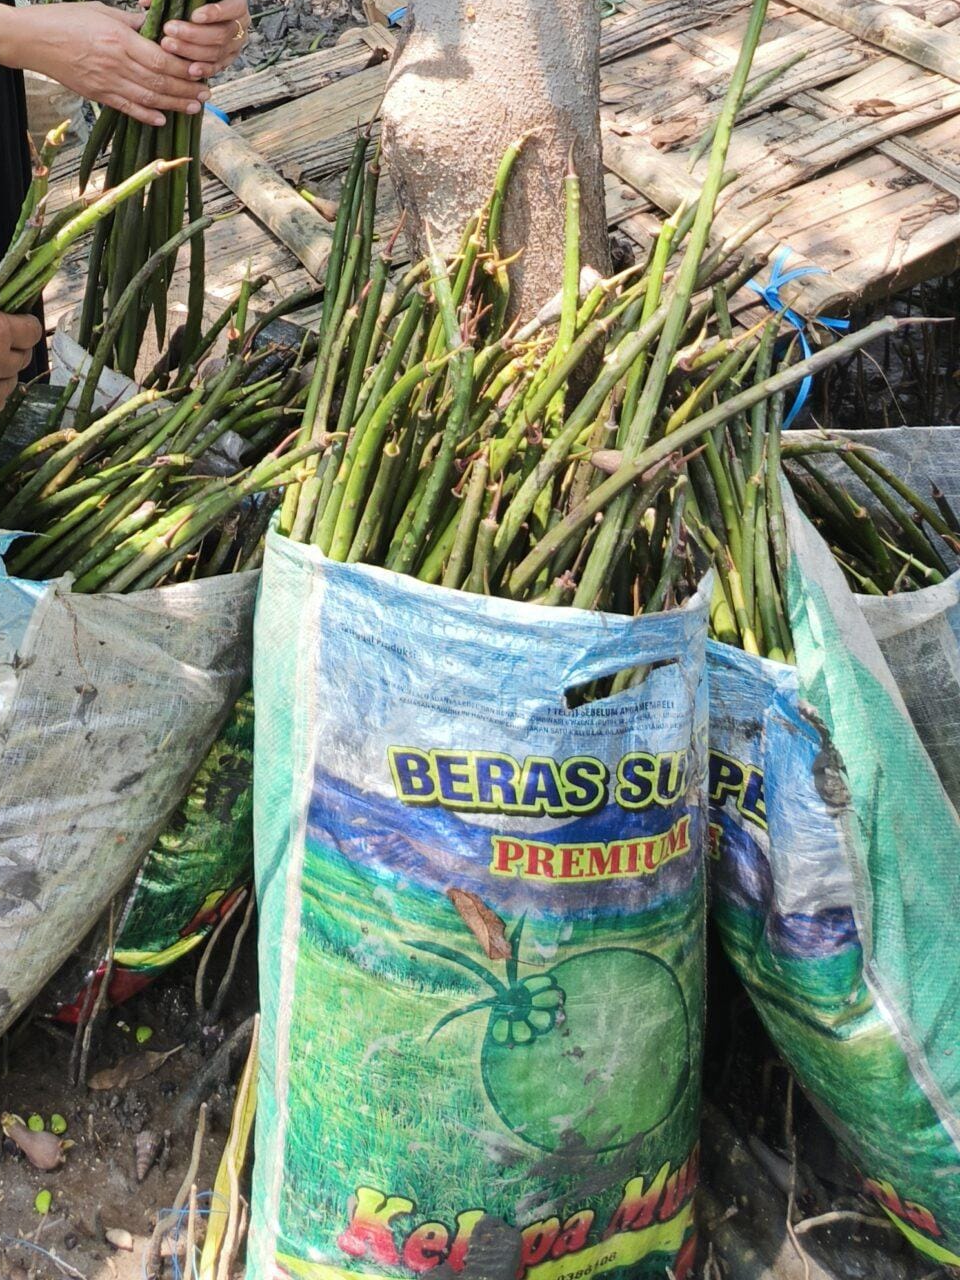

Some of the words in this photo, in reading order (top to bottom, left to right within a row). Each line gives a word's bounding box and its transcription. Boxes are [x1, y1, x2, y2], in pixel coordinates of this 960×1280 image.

[390, 747, 608, 815] BERAS
[491, 816, 691, 882] PREMIUM
[338, 1186, 595, 1280] Kelpa
